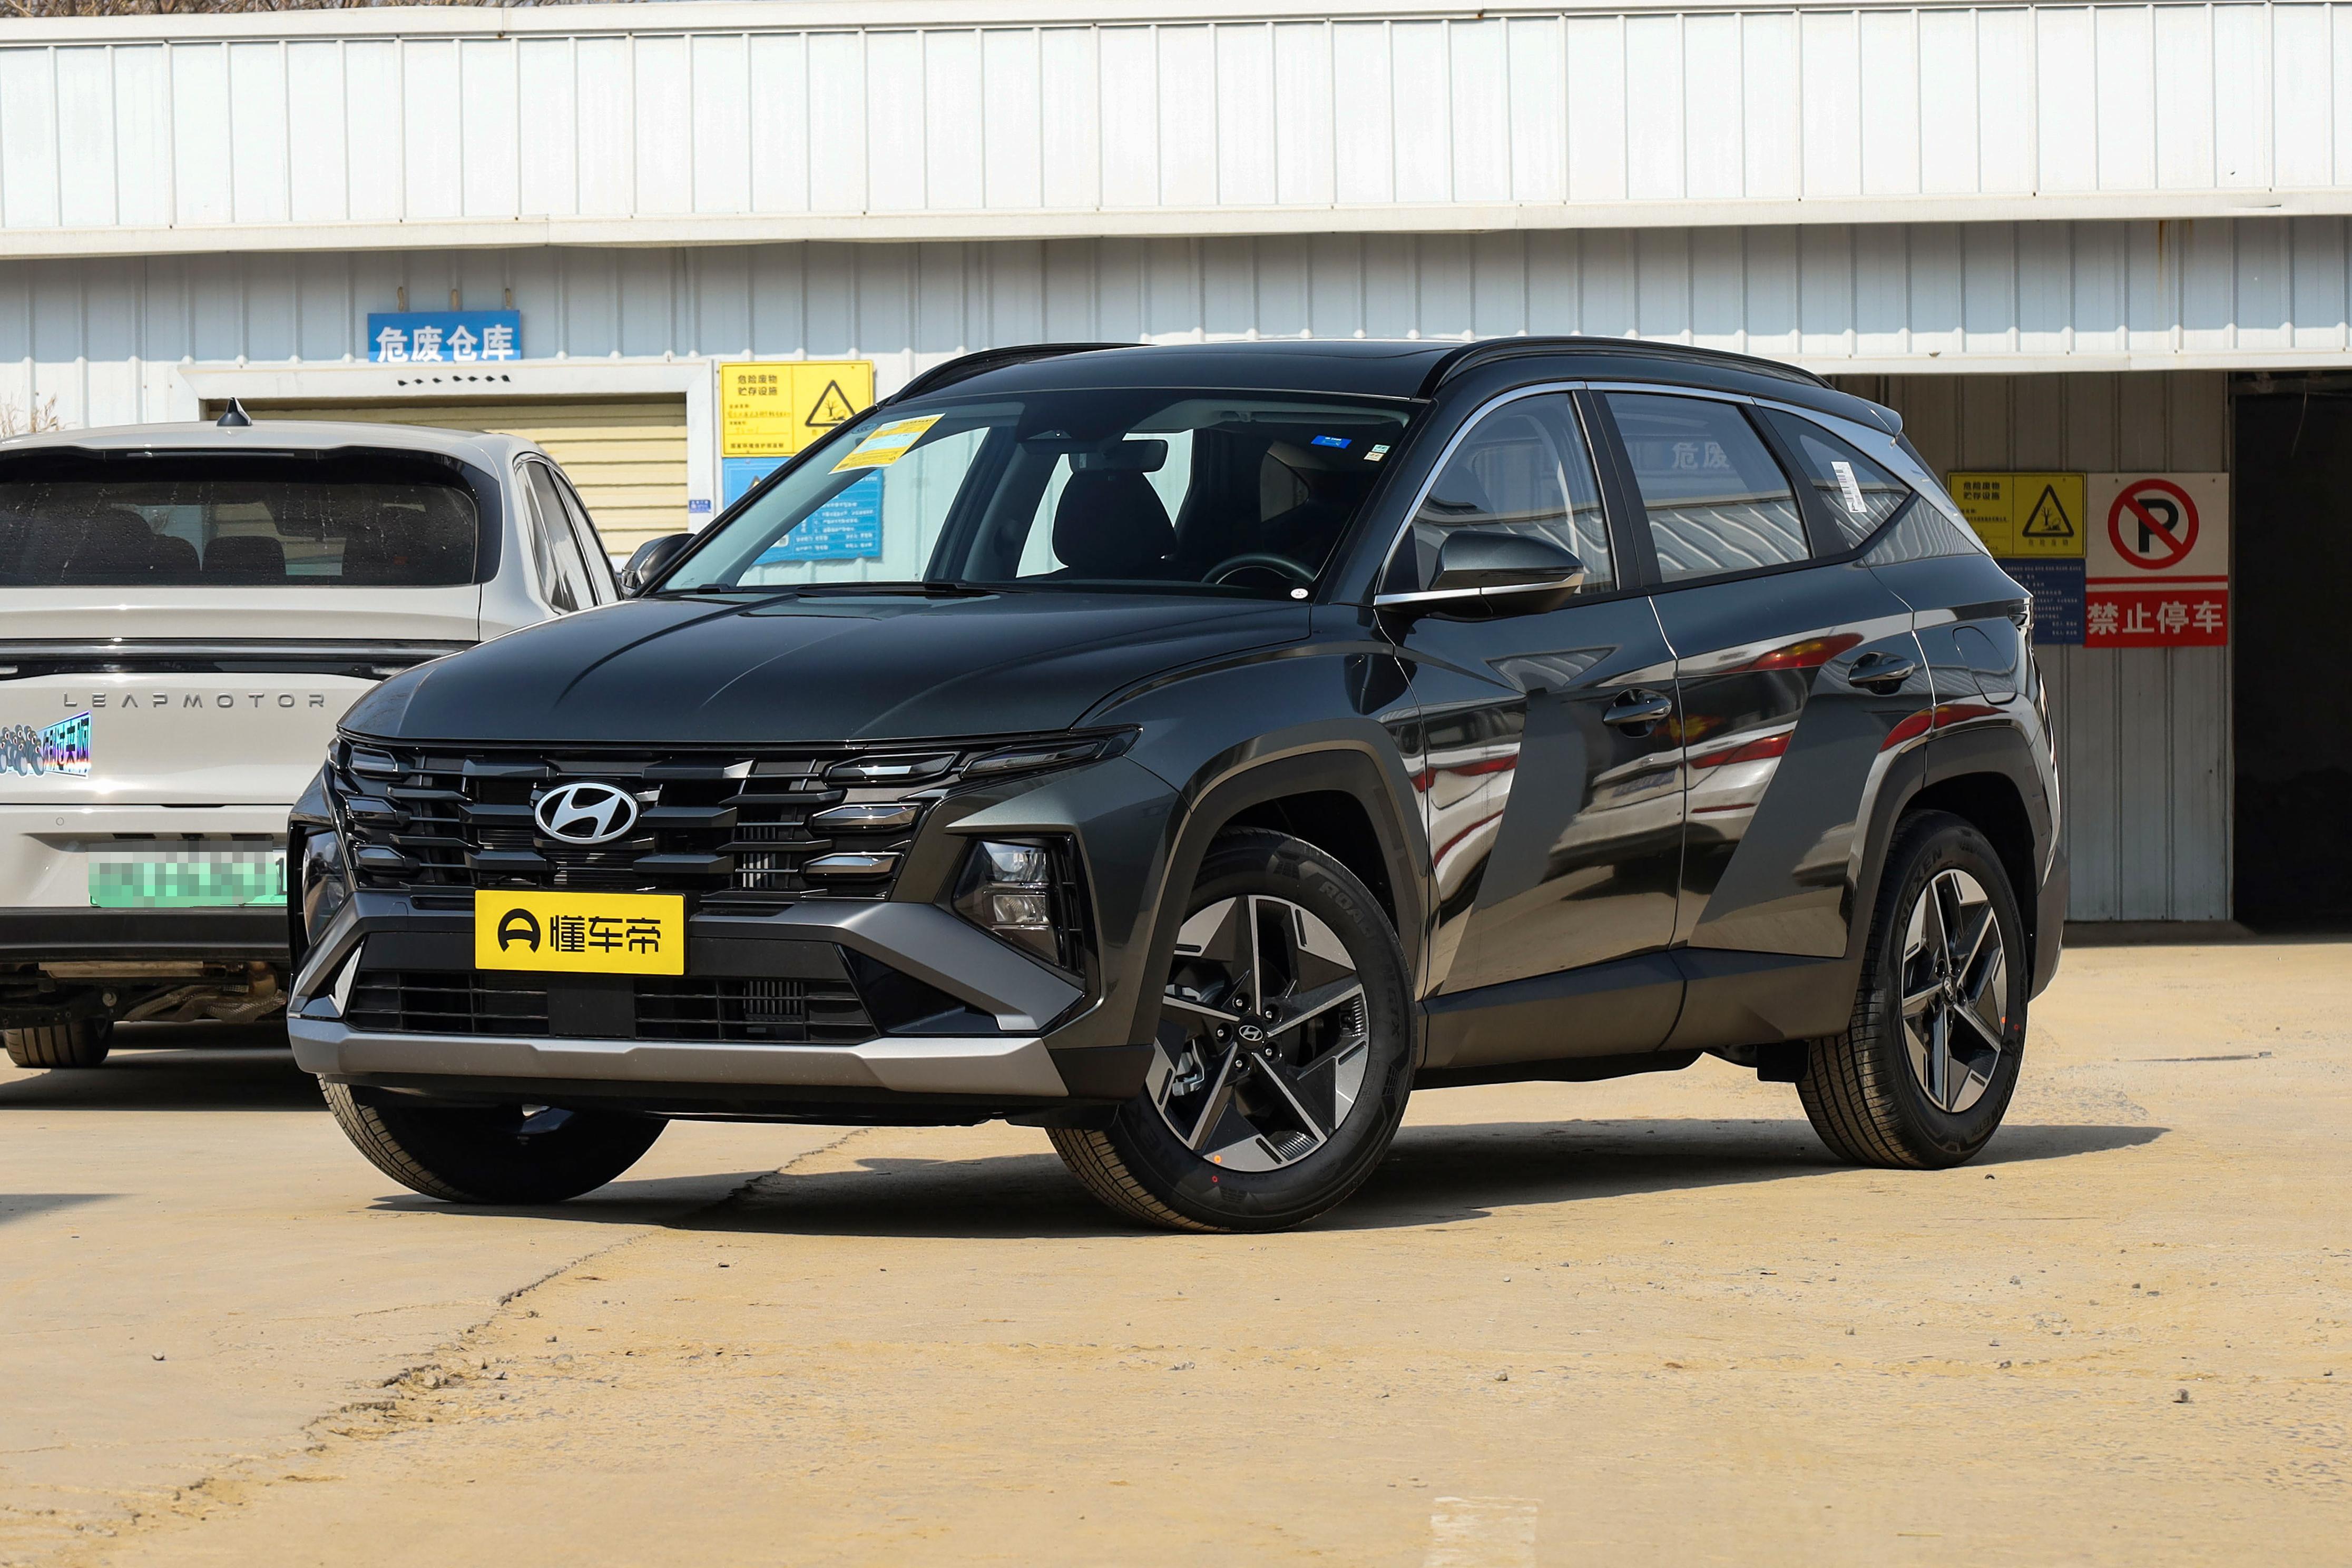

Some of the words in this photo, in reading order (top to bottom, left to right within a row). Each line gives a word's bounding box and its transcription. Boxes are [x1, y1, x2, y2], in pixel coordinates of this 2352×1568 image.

[375, 324, 514, 363] 危废仓库
[738, 375, 778, 384] 危险废物
[738, 387, 778, 396] 贮存设施
[1963, 482, 2000, 490] 危险废物
[2087, 600, 2223, 635] 禁止停车
[63, 692, 326, 709] LEAPMOTOR
[550, 914, 661, 954] 懂车帝
